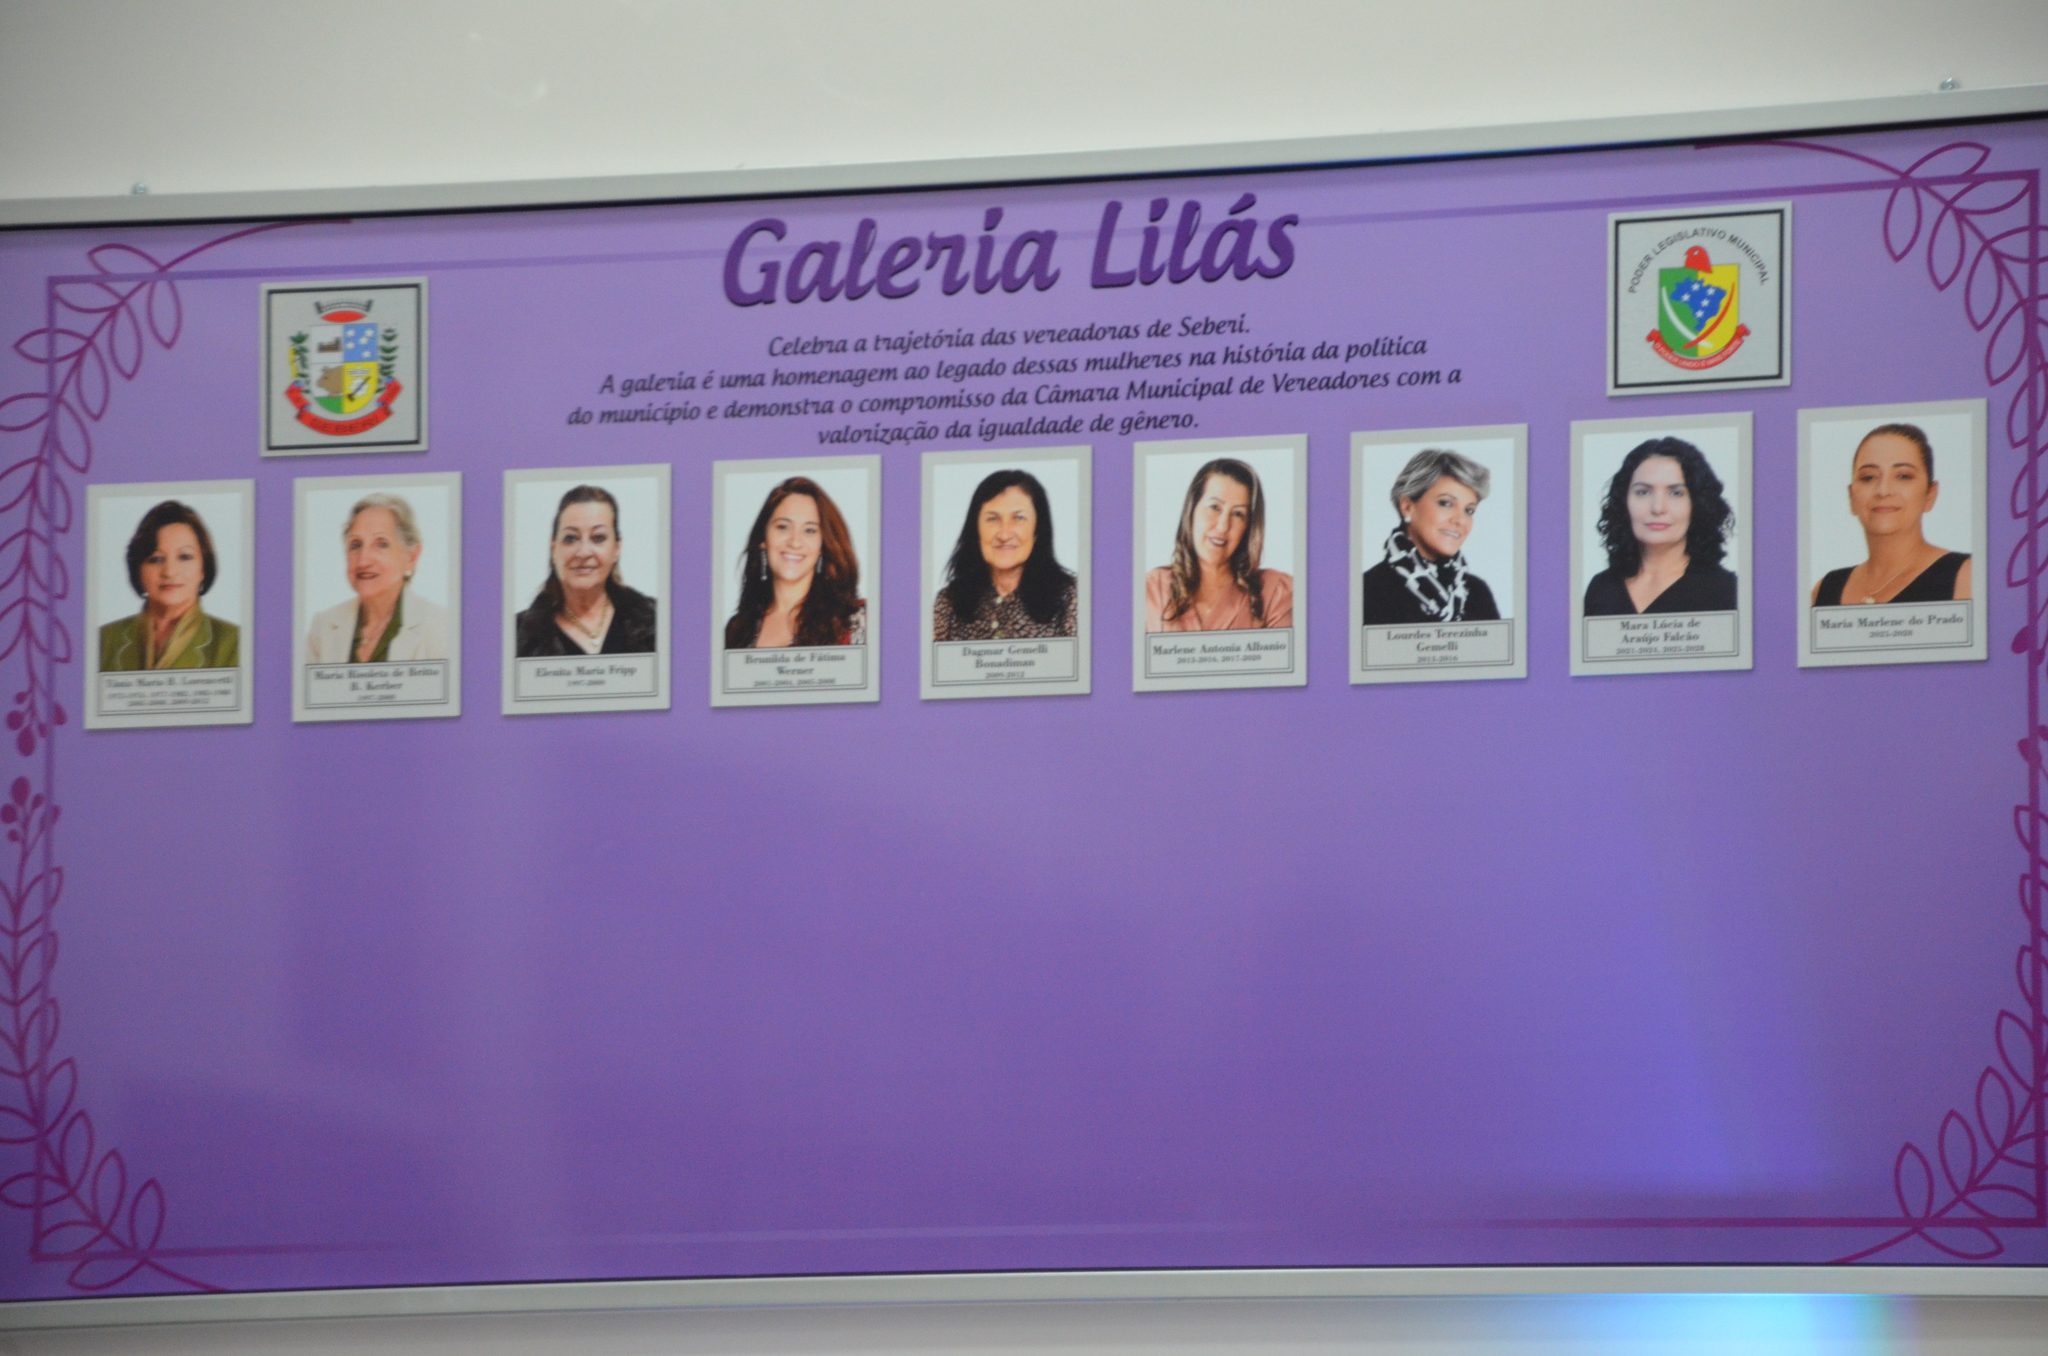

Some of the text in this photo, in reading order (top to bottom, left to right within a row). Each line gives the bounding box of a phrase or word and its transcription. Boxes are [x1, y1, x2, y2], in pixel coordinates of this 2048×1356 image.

[722, 193, 1299, 307] Galeria Lilás
[1628, 227, 1770, 294] PODER LEGISLATIVO MUNICIPAL
[768, 313, 1250, 356] Celebra a trajetória das vereadoras de Seberi.
[599, 335, 1427, 397] A galeria é uma homenagem ao legado dessas mulheres na história da política
[567, 368, 1462, 425] do município e demonstra o compromisso da Câmara Municipal de Vereadores com a
[818, 411, 1199, 445] valorização da igualdade de gênero.
[1620, 618, 1700, 631] Mara Lúcia de
[1820, 614, 1963, 629] Maria Marlene do Prado
[1387, 628, 1488, 640] Lourdes Terezinha
[1622, 631, 1699, 645] Araújo Falcão
[962, 644, 1048, 657] Dagmar Gemelli
[1153, 645, 1195, 655] Marlene
[1417, 641, 1458, 651] Gemelli
[794, 653, 806, 663] de
[576, 666, 605, 676] Maria
